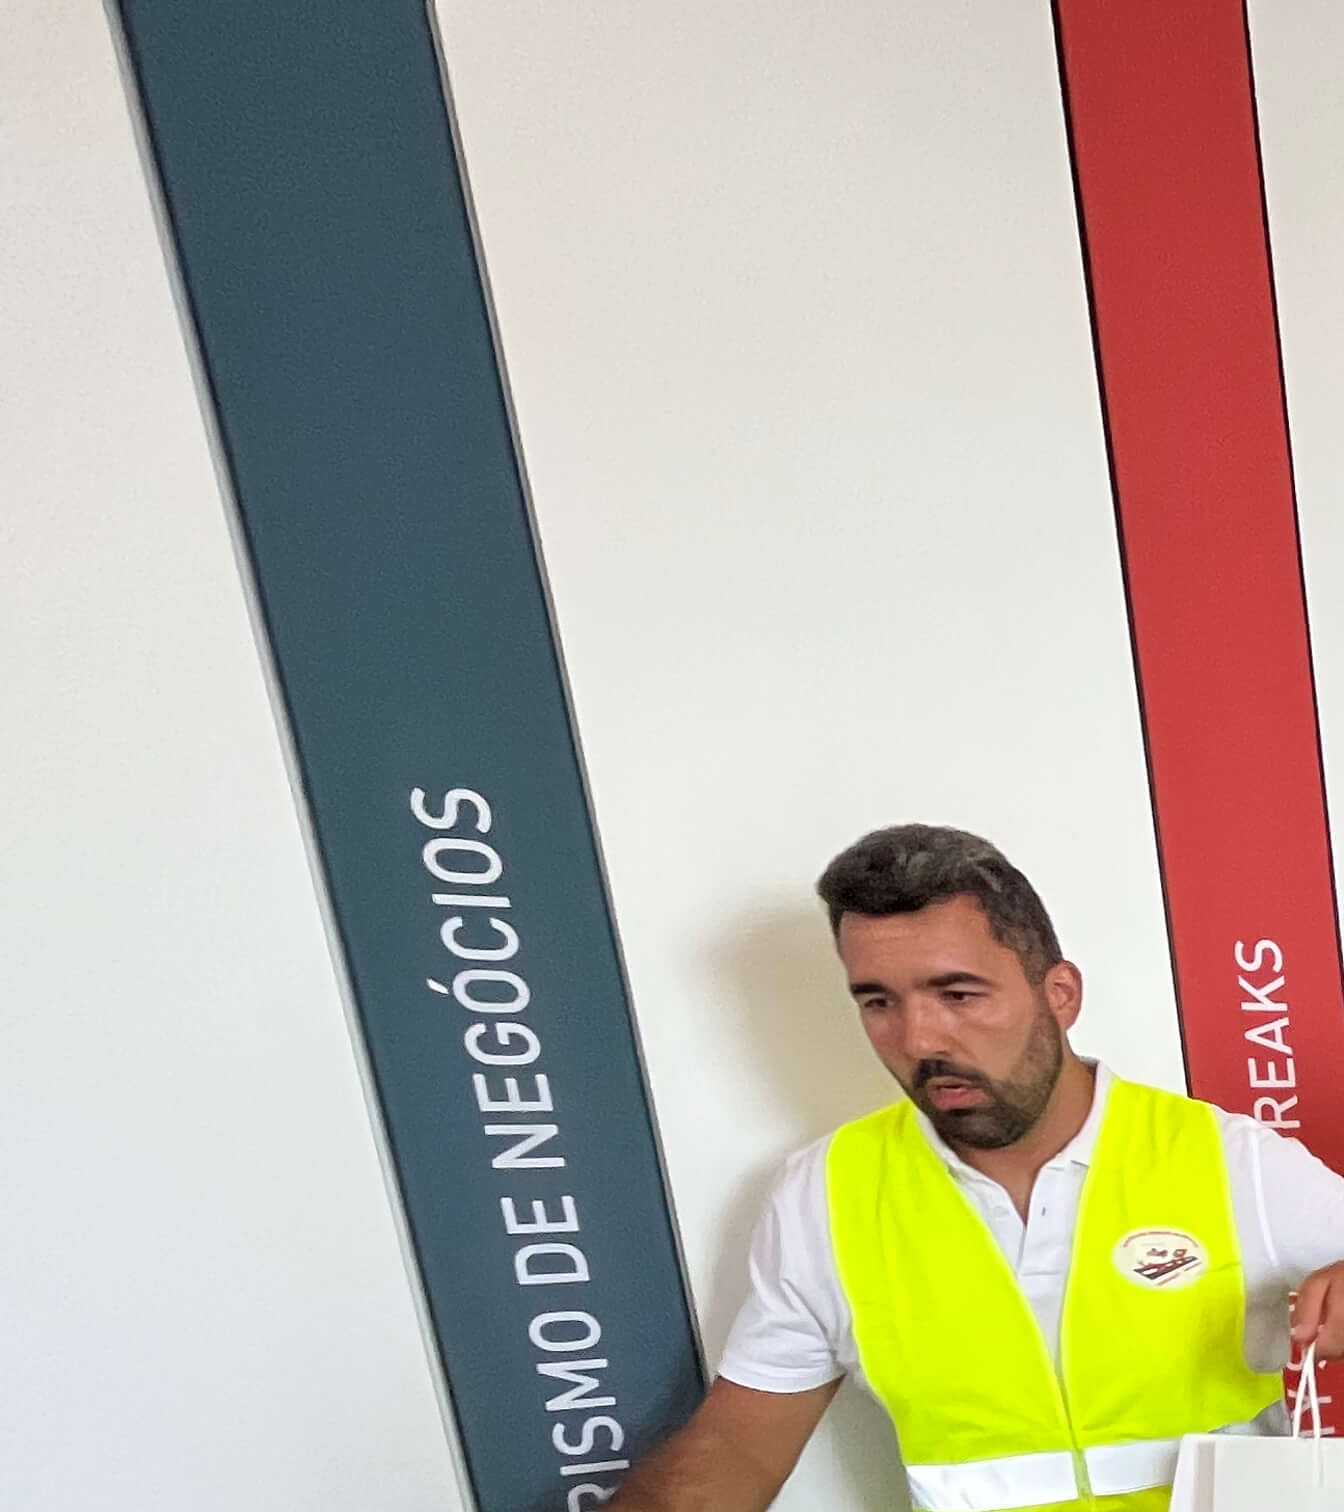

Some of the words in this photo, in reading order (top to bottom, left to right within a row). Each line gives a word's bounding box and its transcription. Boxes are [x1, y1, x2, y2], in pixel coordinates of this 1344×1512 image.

[409, 786, 567, 1171] NEGÓCIOS
[1234, 938, 1301, 1130] REAKS
[501, 1194, 590, 1287] DE
